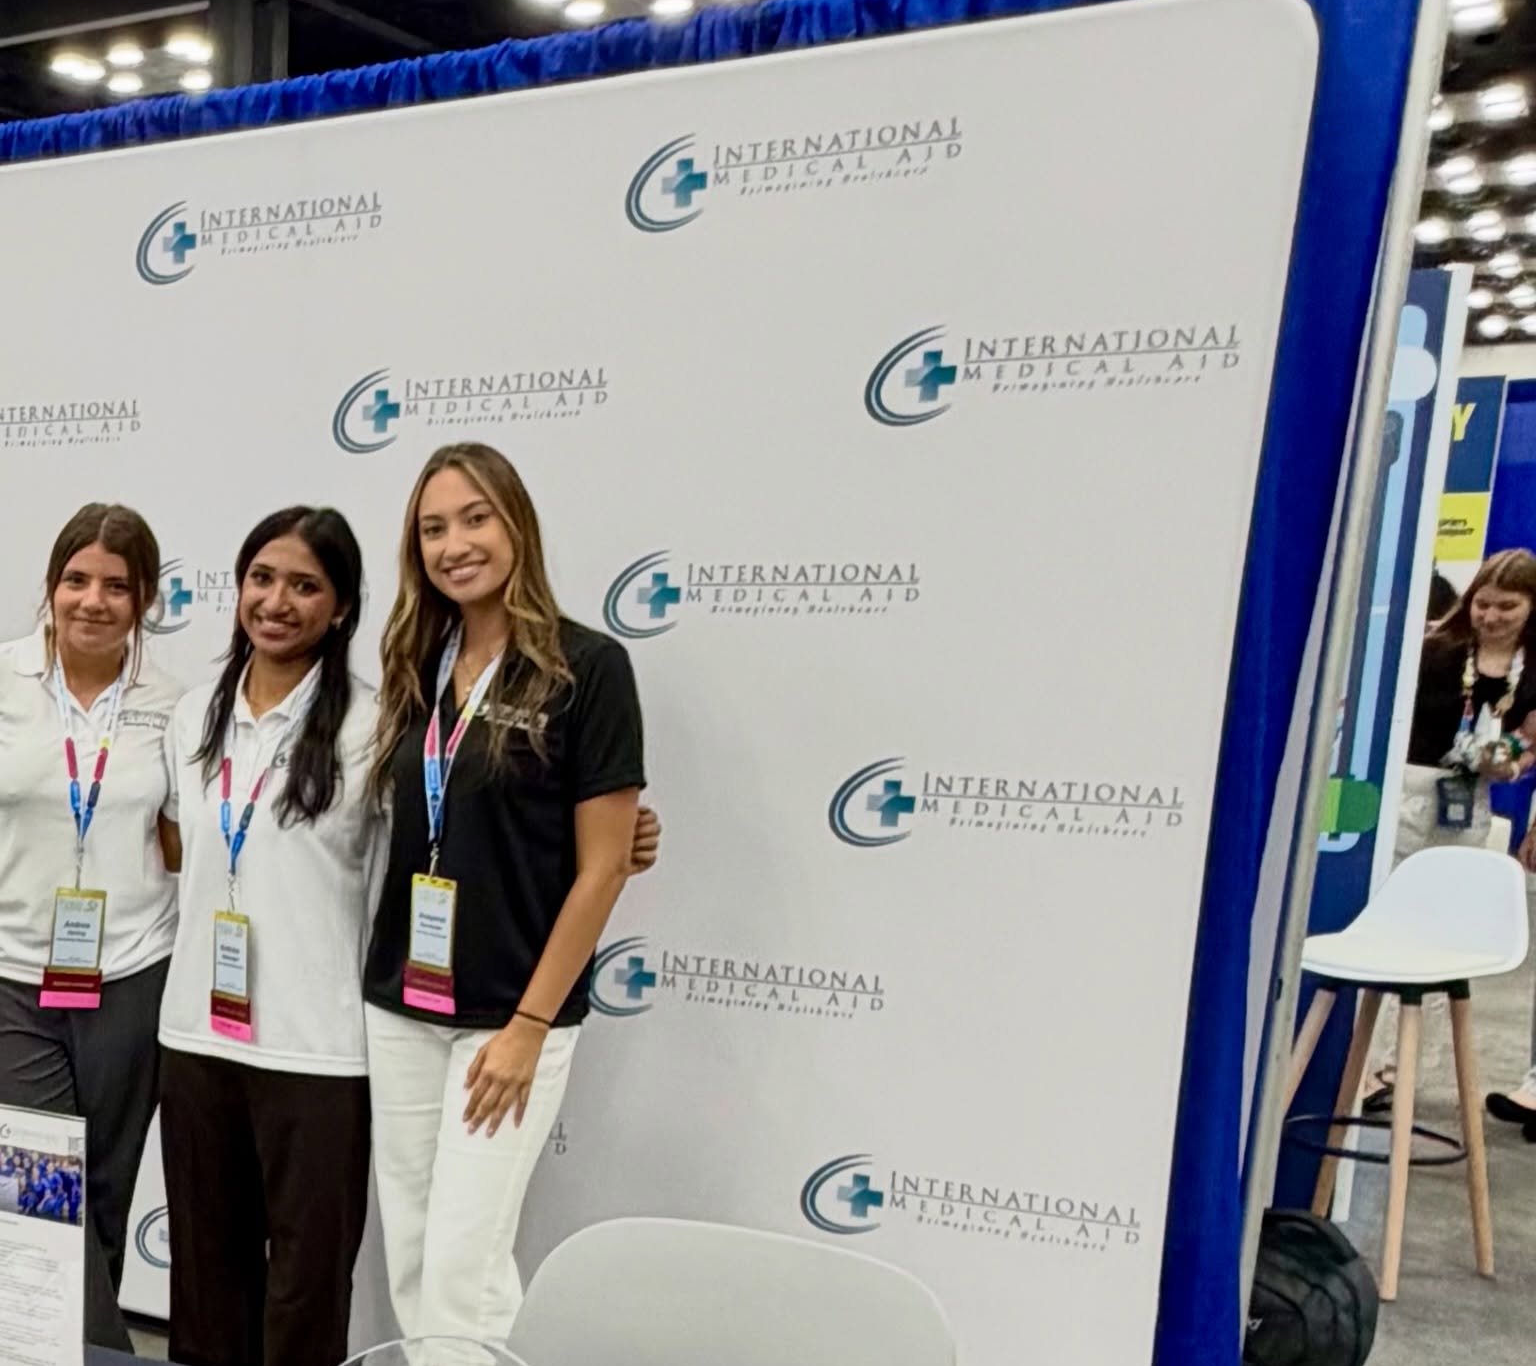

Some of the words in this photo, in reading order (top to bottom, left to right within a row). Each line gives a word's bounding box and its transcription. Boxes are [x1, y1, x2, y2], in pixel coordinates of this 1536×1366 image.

[714, 116, 962, 166] INTERNATIONAL
[713, 154, 867, 187] MEDICAL
[898, 143, 962, 165] AID
[201, 191, 381, 229] INTERNATIONAL
[201, 222, 314, 247] MEDICAL
[335, 214, 382, 232] AID
[965, 324, 1240, 359] INTERNATIONAL
[405, 367, 607, 398] INTERNATIONAL
[963, 357, 1134, 381] MEDICAL
[1168, 352, 1240, 371] AID
[405, 395, 531, 416] MEDICAL
[556, 391, 607, 407] AID
[101, 420, 140, 433] AID
[687, 563, 920, 583] INTERNATIONAL
[686, 588, 831, 602] MEDICAL
[860, 587, 920, 602] AID
[923, 772, 1183, 807] INTERNATIONAL
[921, 798, 1083, 821] MEDICAL
[1116, 809, 1183, 827] AID
[662, 951, 884, 994] INTERNATIONAL
[661, 974, 800, 1002] MEDICAL
[827, 992, 884, 1012] AID
[890, 1170, 1140, 1227] INTERNATIONAL
[889, 1194, 1045, 1231] MEDICAL
[1076, 1223, 1140, 1246] AID
